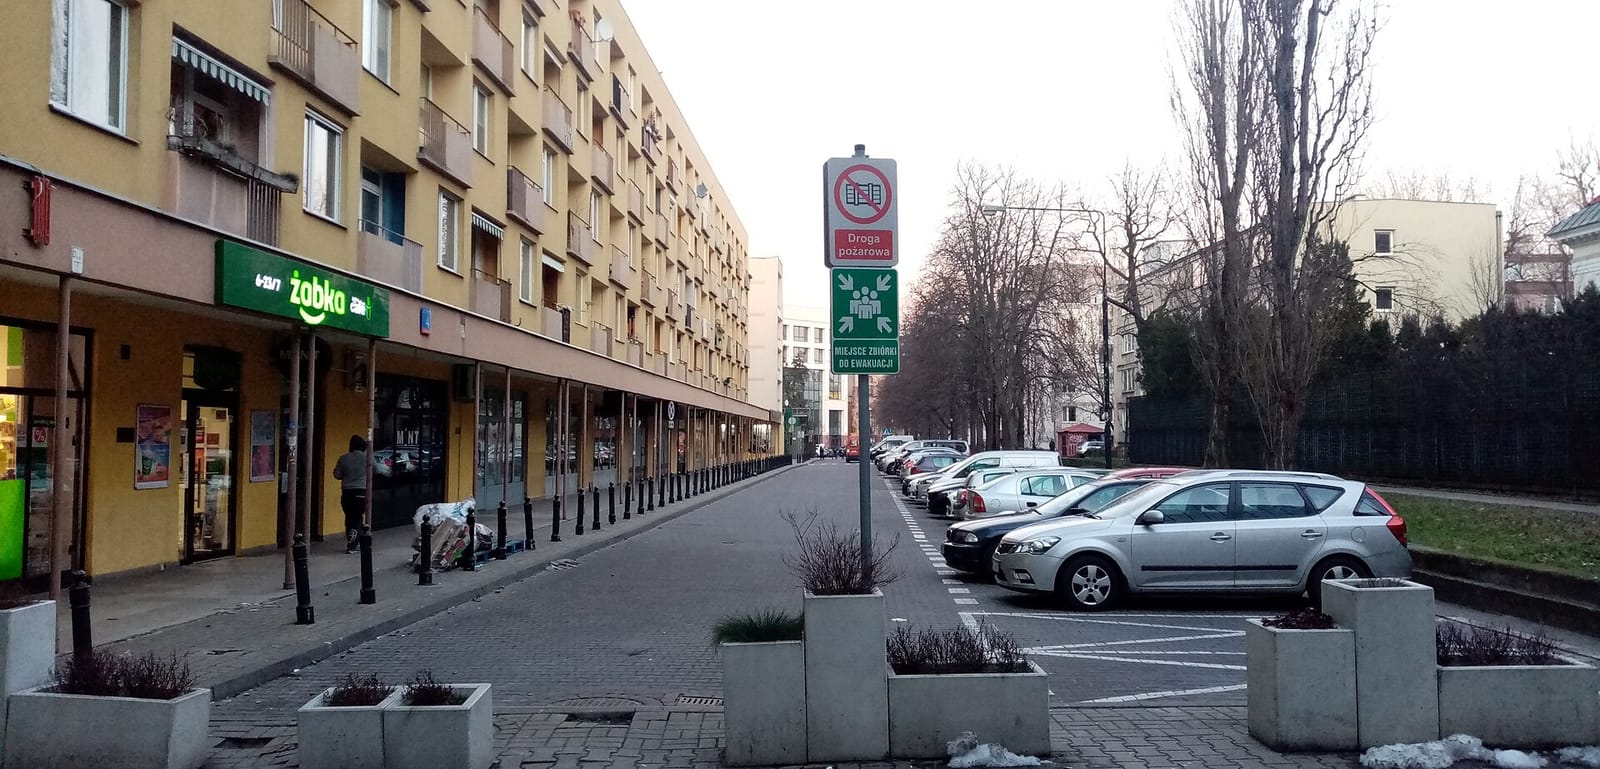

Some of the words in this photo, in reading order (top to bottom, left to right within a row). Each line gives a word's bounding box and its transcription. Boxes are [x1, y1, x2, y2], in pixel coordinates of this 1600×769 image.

[848, 233, 881, 245] Droga
[839, 246, 890, 258] pożarowa
[289, 269, 345, 316] żabka
[279, 348, 321, 361] MNT
[834, 346, 867, 356] MIEJSCE
[868, 345, 897, 356] ZBIÓRKI
[839, 359, 849, 368] DO
[851, 359, 893, 368] EWAKUACJI
